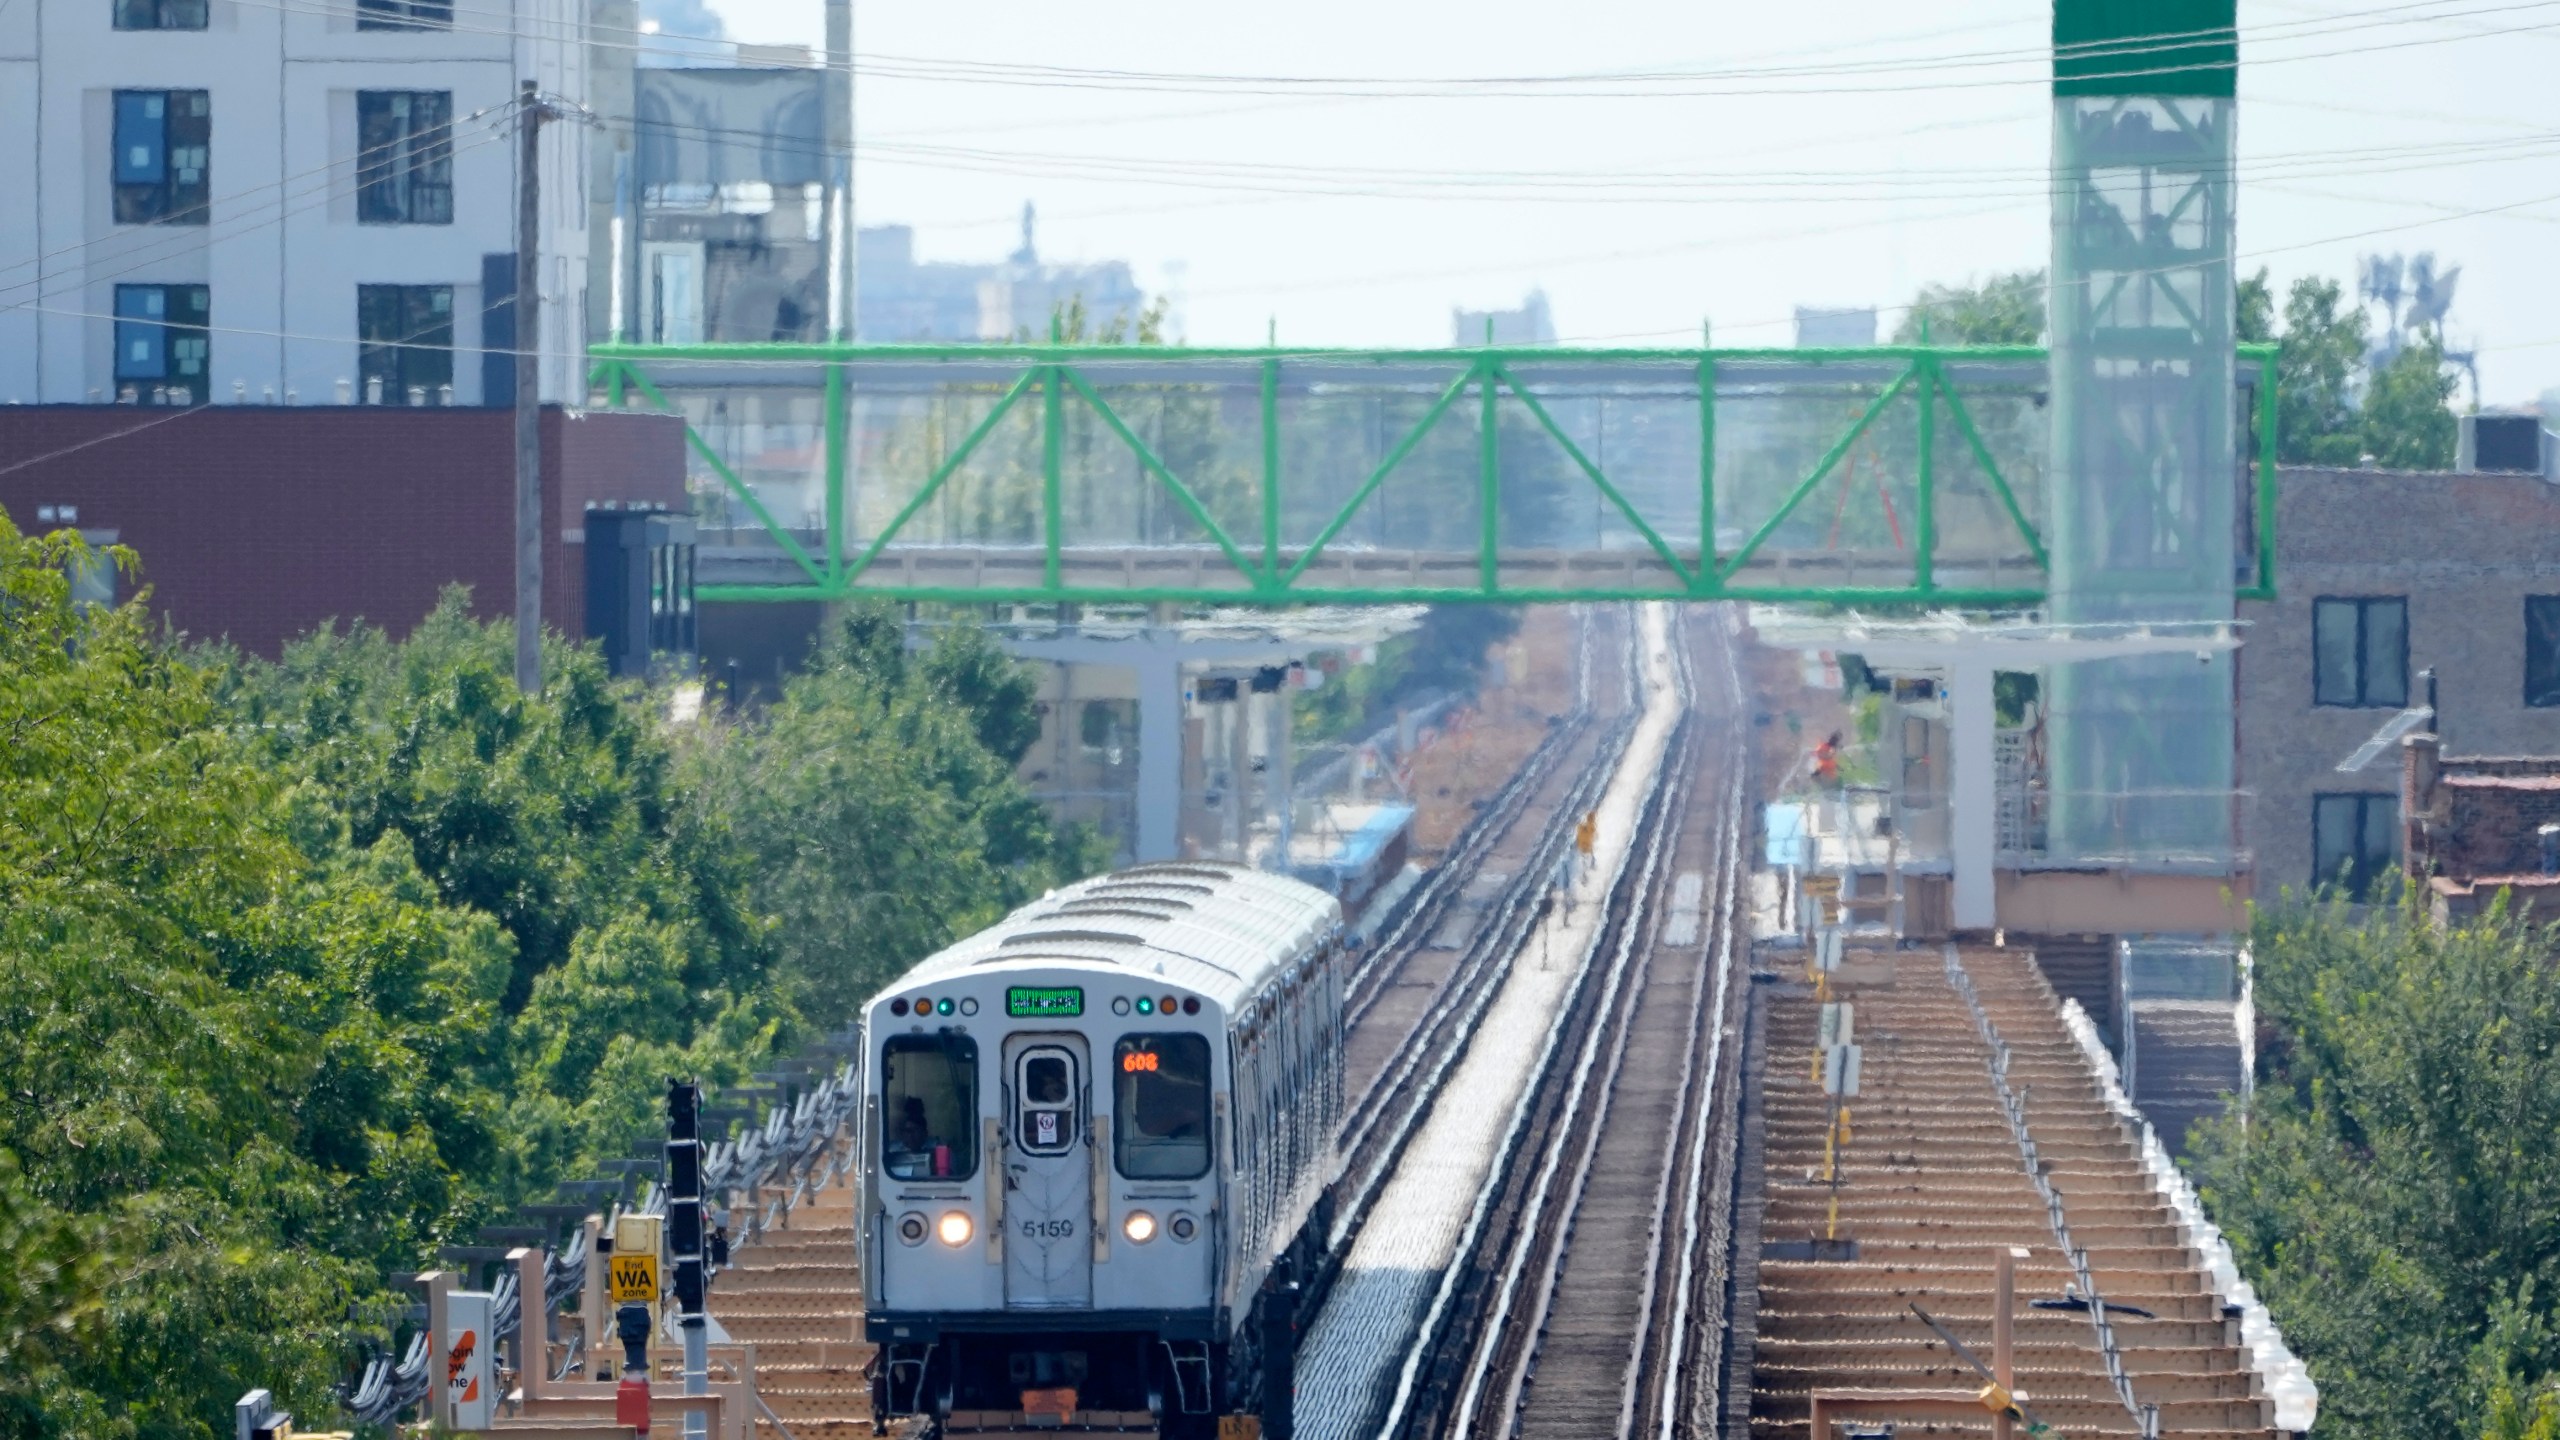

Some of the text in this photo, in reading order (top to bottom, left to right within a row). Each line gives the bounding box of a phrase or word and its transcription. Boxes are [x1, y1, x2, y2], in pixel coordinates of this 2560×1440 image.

[1022, 1219, 1073, 1238] 5159
[624, 1260, 644, 1270] End
[616, 1270, 652, 1288] WA
[623, 1289, 648, 1298] zone
